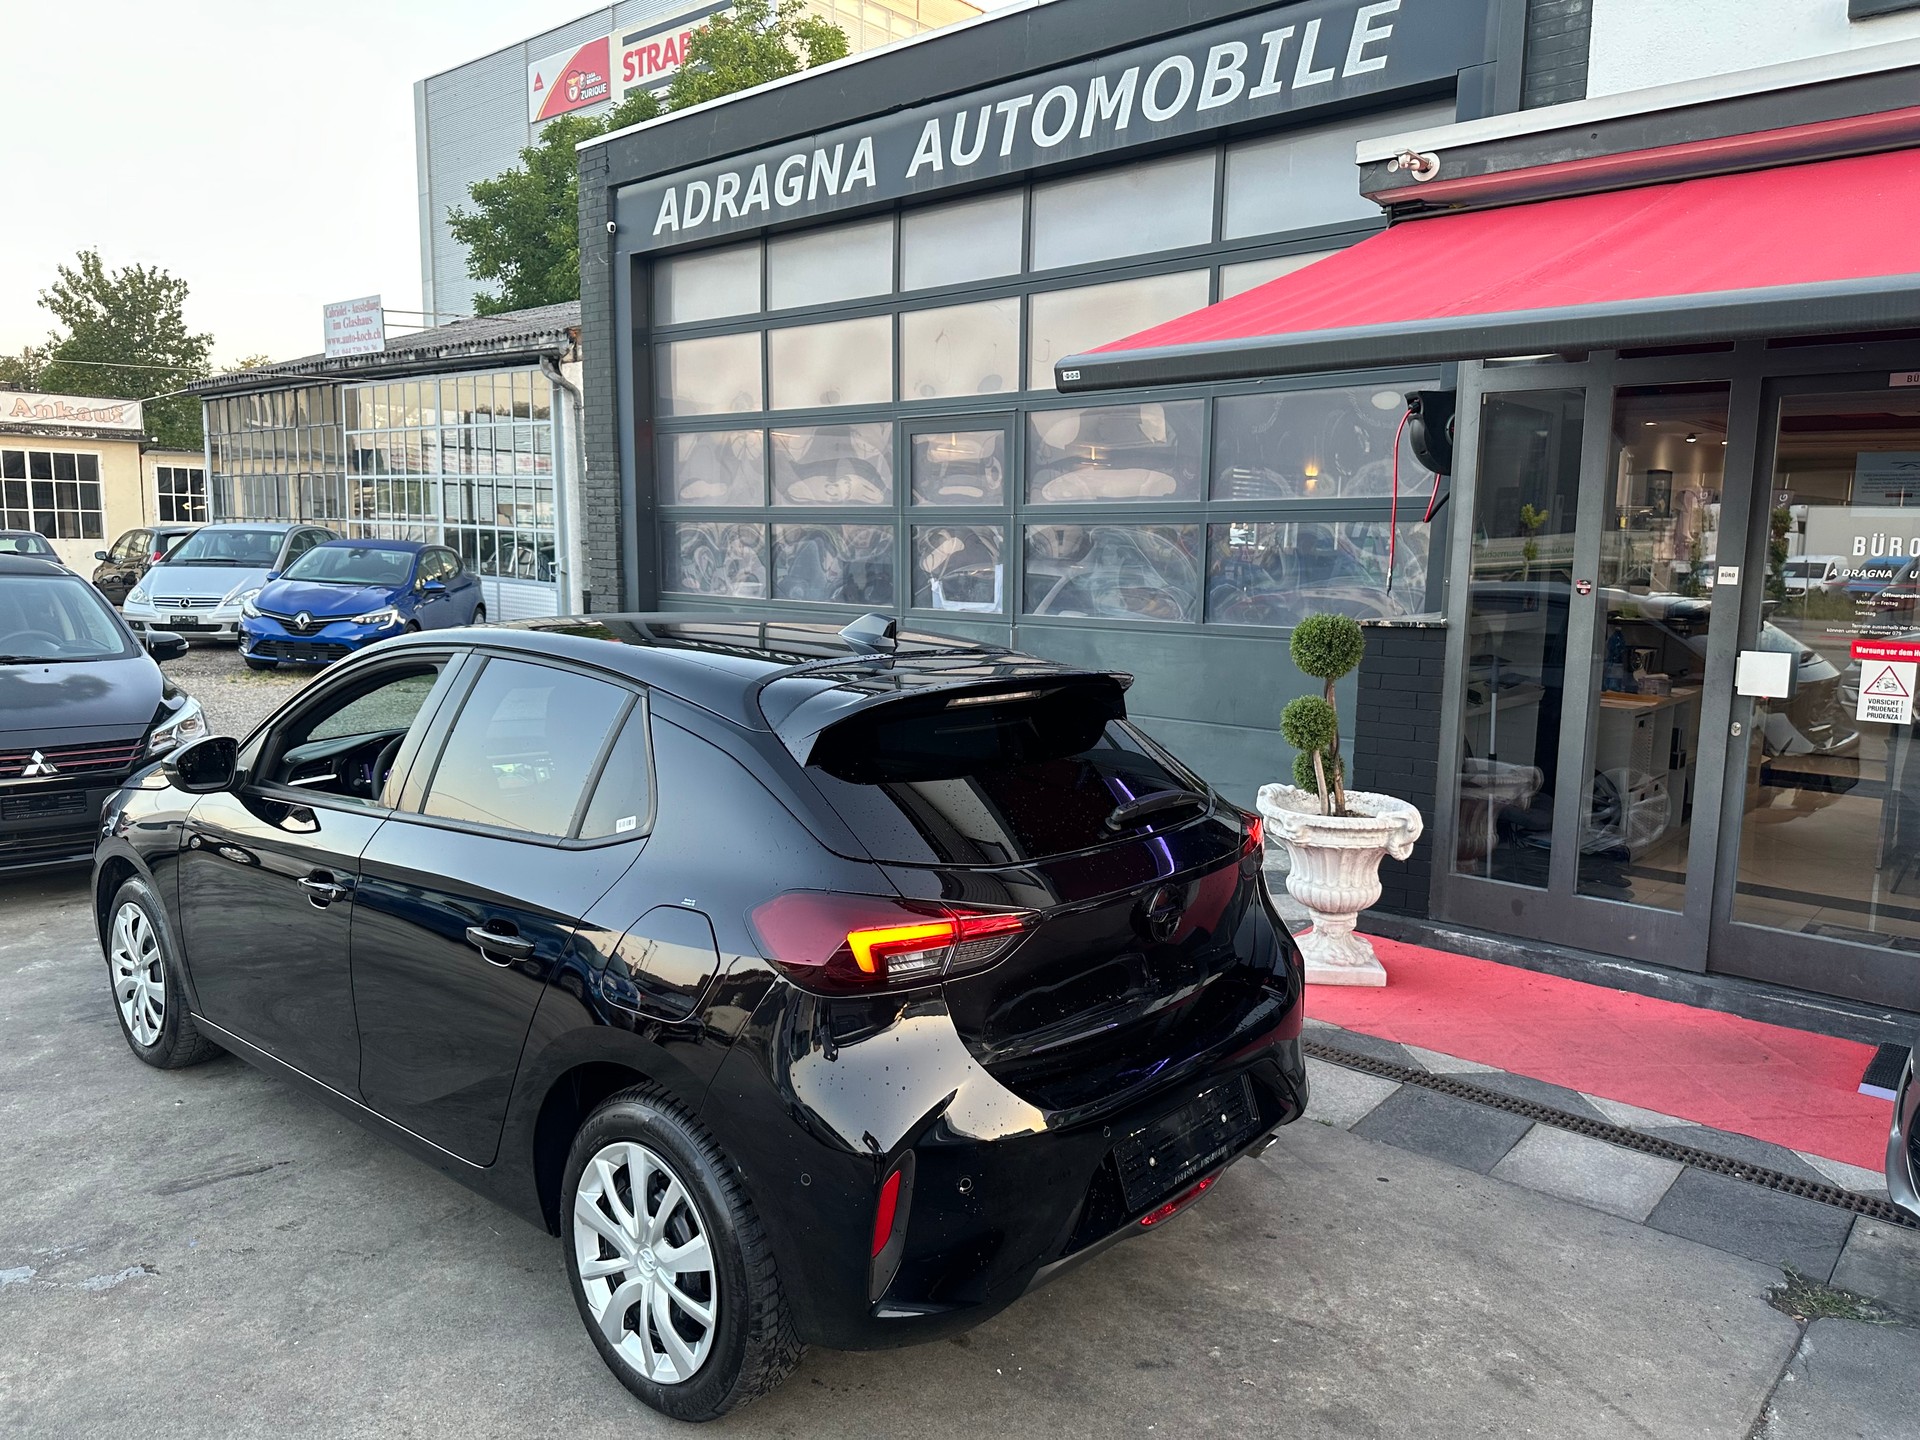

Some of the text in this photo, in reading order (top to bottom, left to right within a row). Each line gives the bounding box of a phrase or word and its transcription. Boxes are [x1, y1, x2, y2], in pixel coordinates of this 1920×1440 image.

[622, 25, 704, 82] STRAB
[653, 0, 1401, 236] ADRAGNA AUTOMOBILE
[333, 315, 373, 330] im Glashaus
[327, 328, 382, 345] www.auto-koch.ch
[9, 397, 124, 423] Ankauf
[1852, 533, 1920, 558] BÜRO
[1856, 646, 1885, 655] Warnung
[1867, 705, 1899, 713] PRUDENCE
[1868, 698, 1899, 706] VORSICHT
[1866, 712, 1899, 720] PRUDENZA
